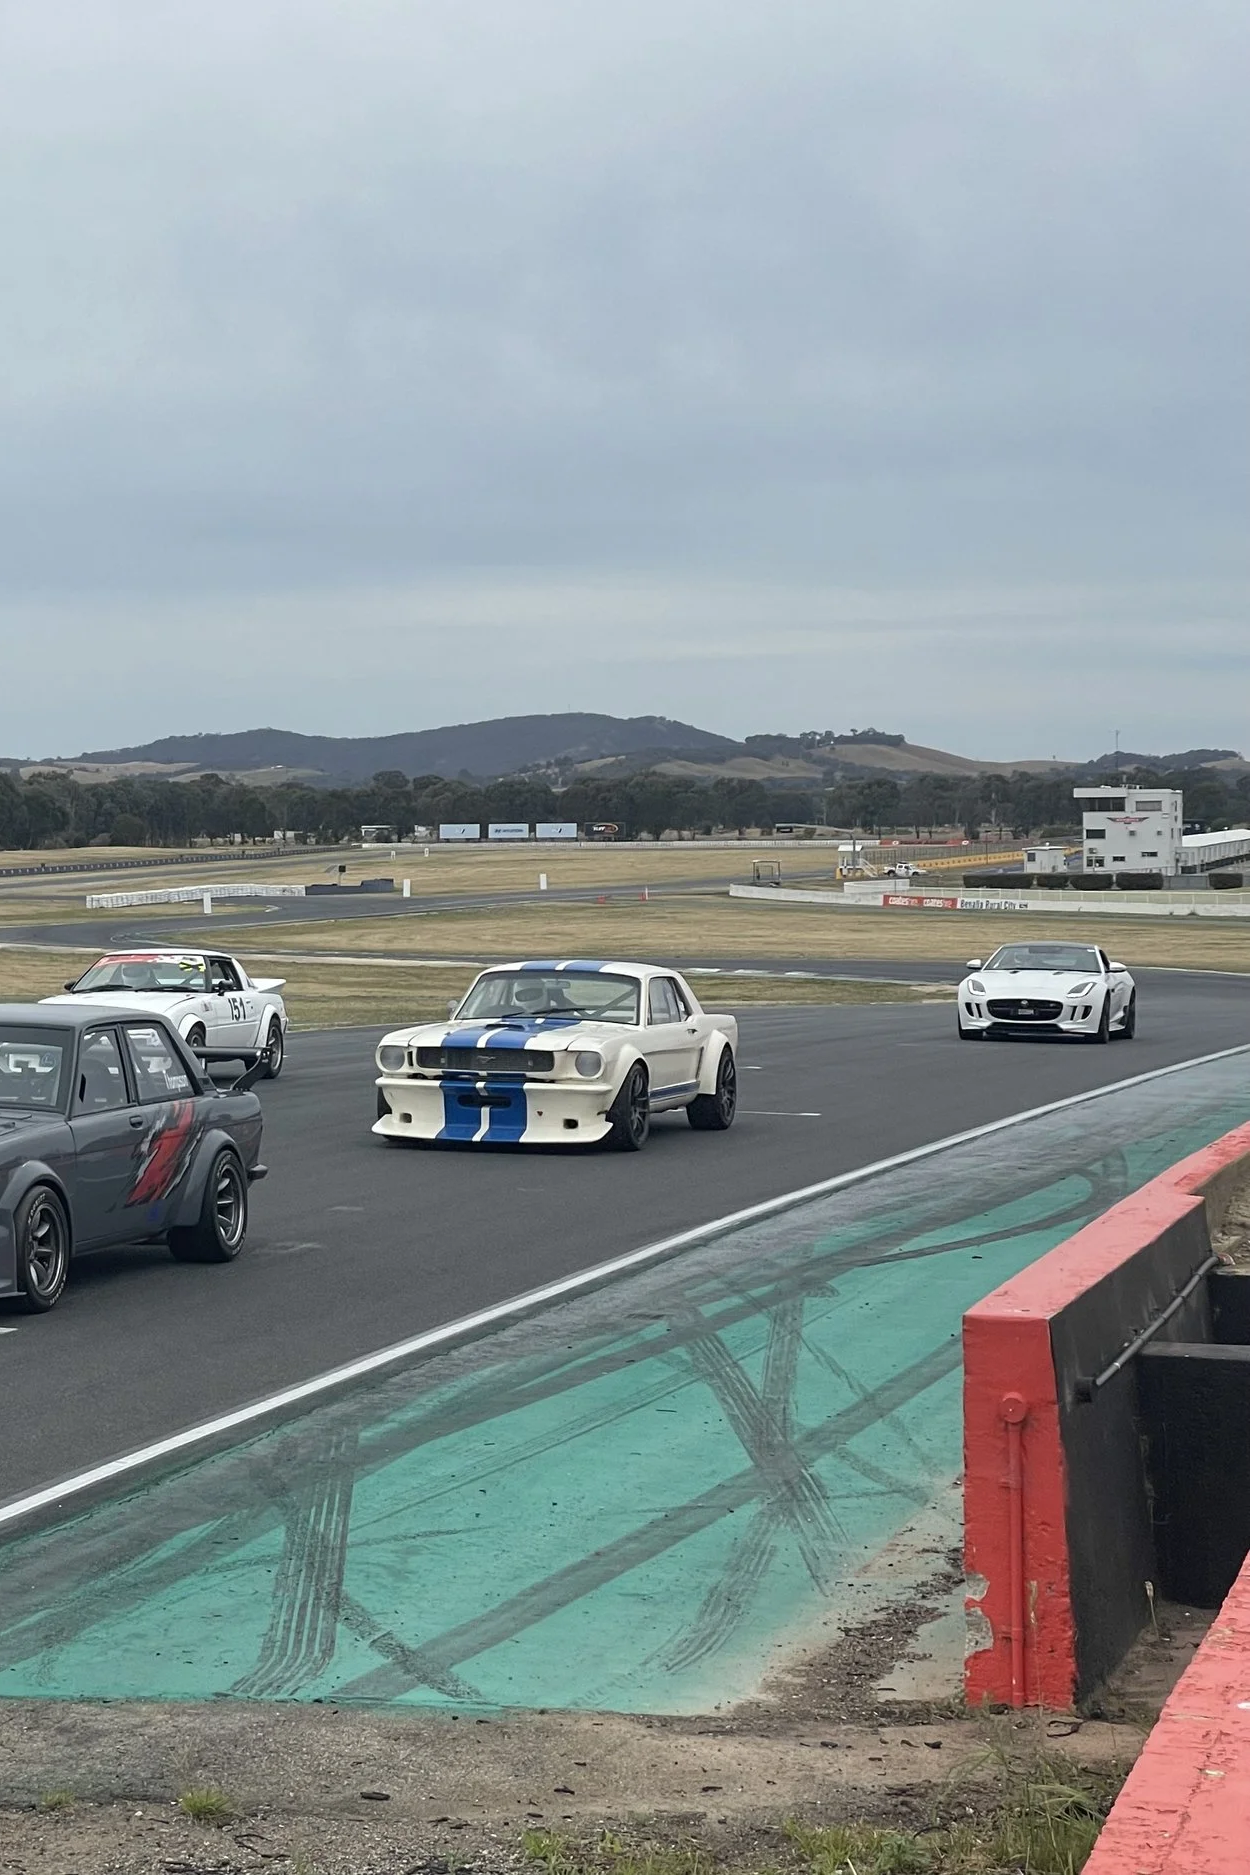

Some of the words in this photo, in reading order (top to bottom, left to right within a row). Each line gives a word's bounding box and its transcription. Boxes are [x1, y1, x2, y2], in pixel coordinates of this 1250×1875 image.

[985, 900, 1001, 909] Rural
[1004, 901, 1016, 910] City
[227, 997, 246, 1022] 151
